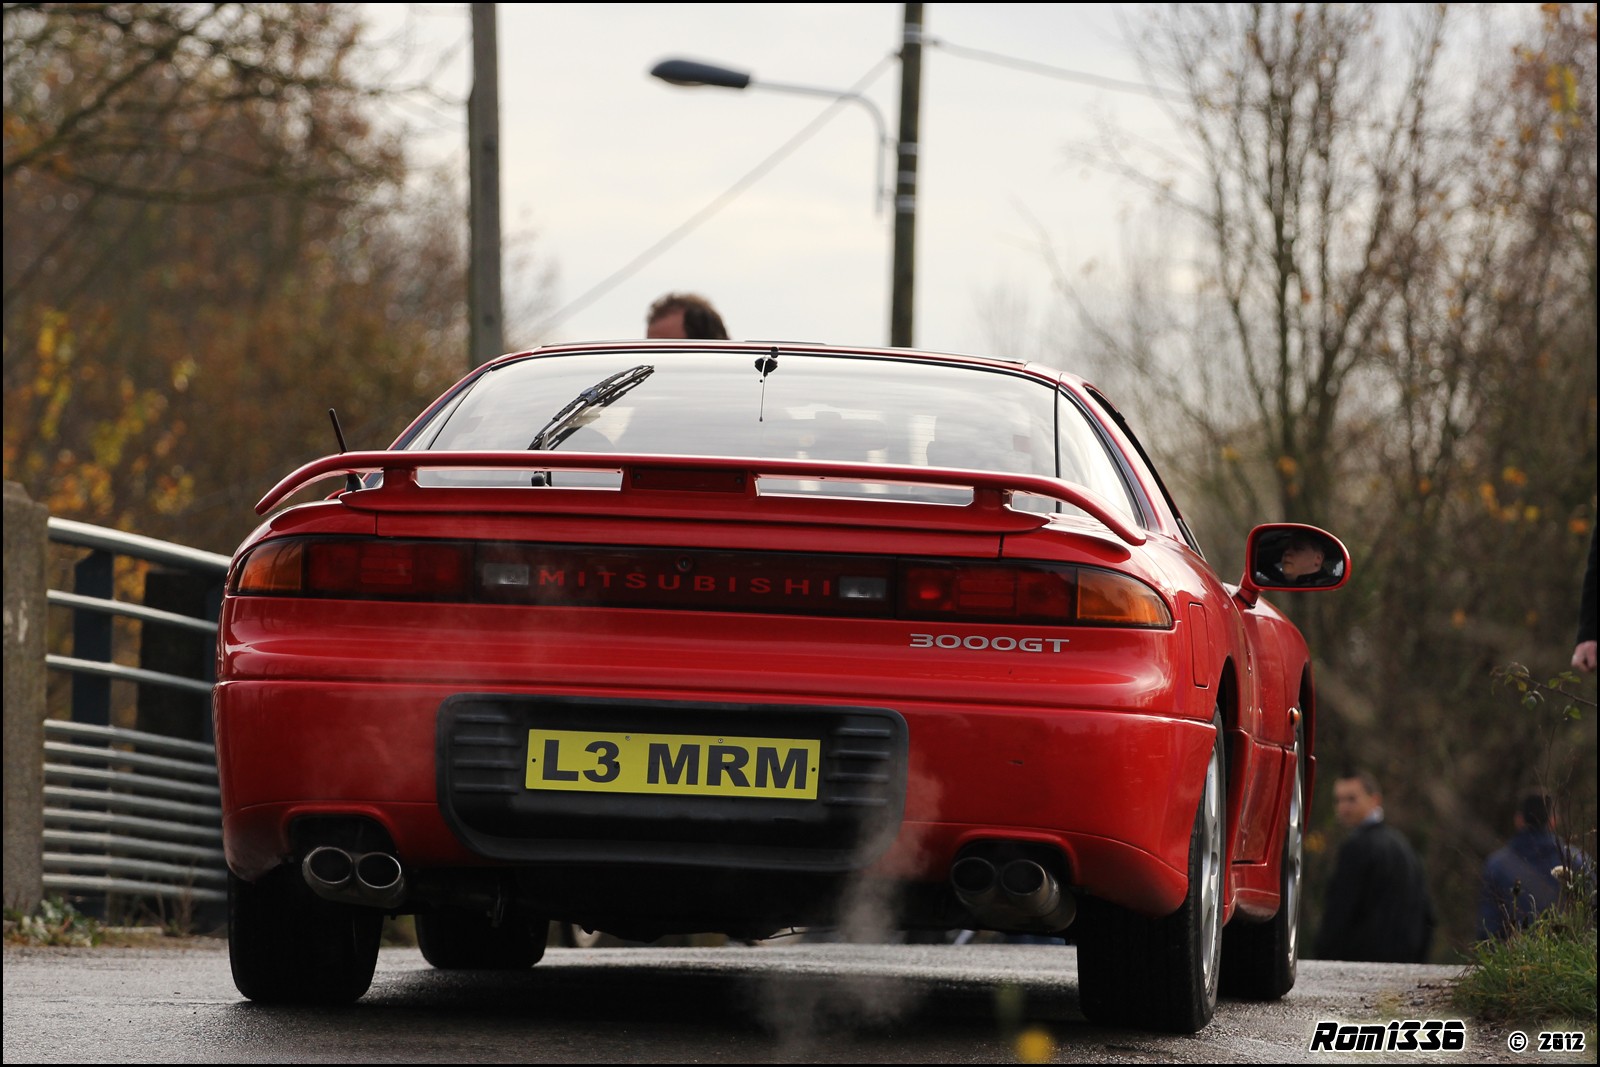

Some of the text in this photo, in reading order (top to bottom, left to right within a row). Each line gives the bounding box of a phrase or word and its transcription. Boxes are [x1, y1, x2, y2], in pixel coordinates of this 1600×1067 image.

[539, 570, 830, 597] MITSUBISHI
[909, 633, 1070, 653] 3000GT
[541, 739, 809, 790] L3 MRM
